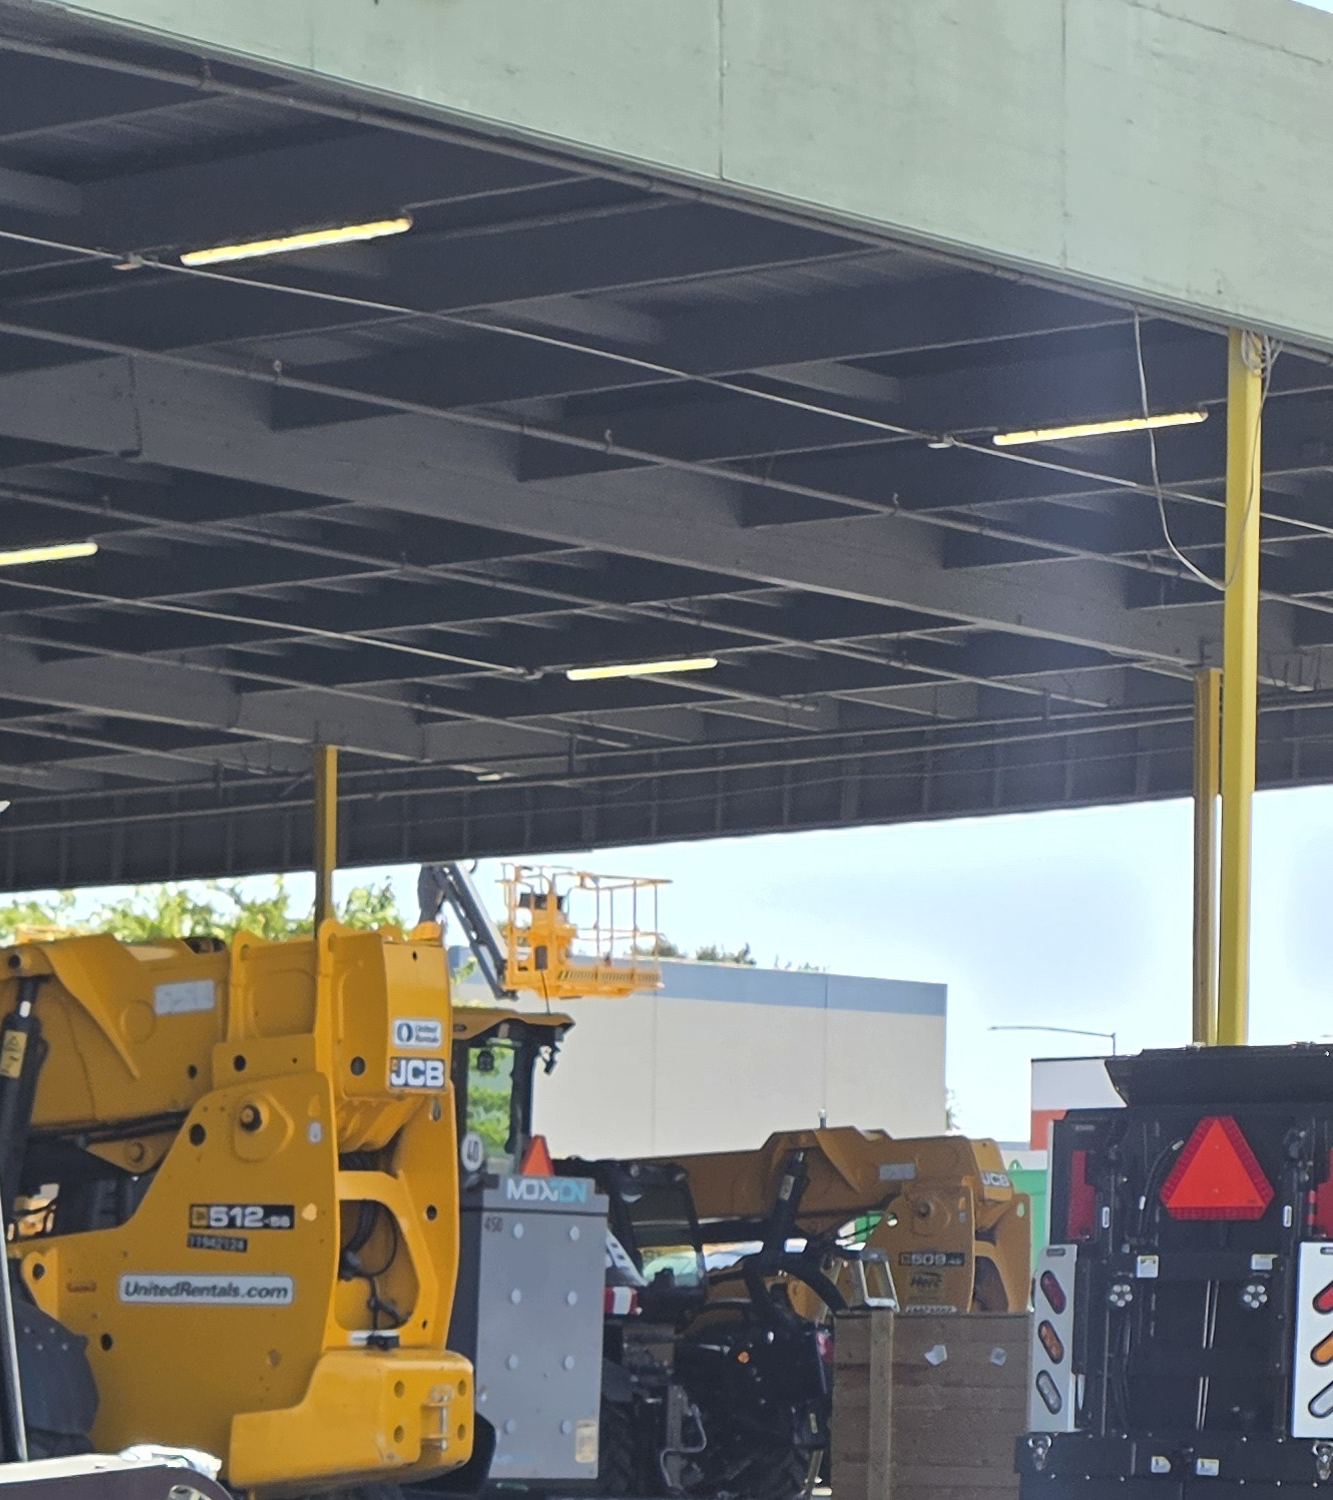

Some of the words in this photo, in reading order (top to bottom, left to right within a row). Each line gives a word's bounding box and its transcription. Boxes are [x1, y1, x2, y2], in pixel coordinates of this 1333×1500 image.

[391, 1060, 444, 1087] JCB
[983, 1174, 1011, 1187] JCB
[124, 1280, 289, 1299] UnitedRentals.com
